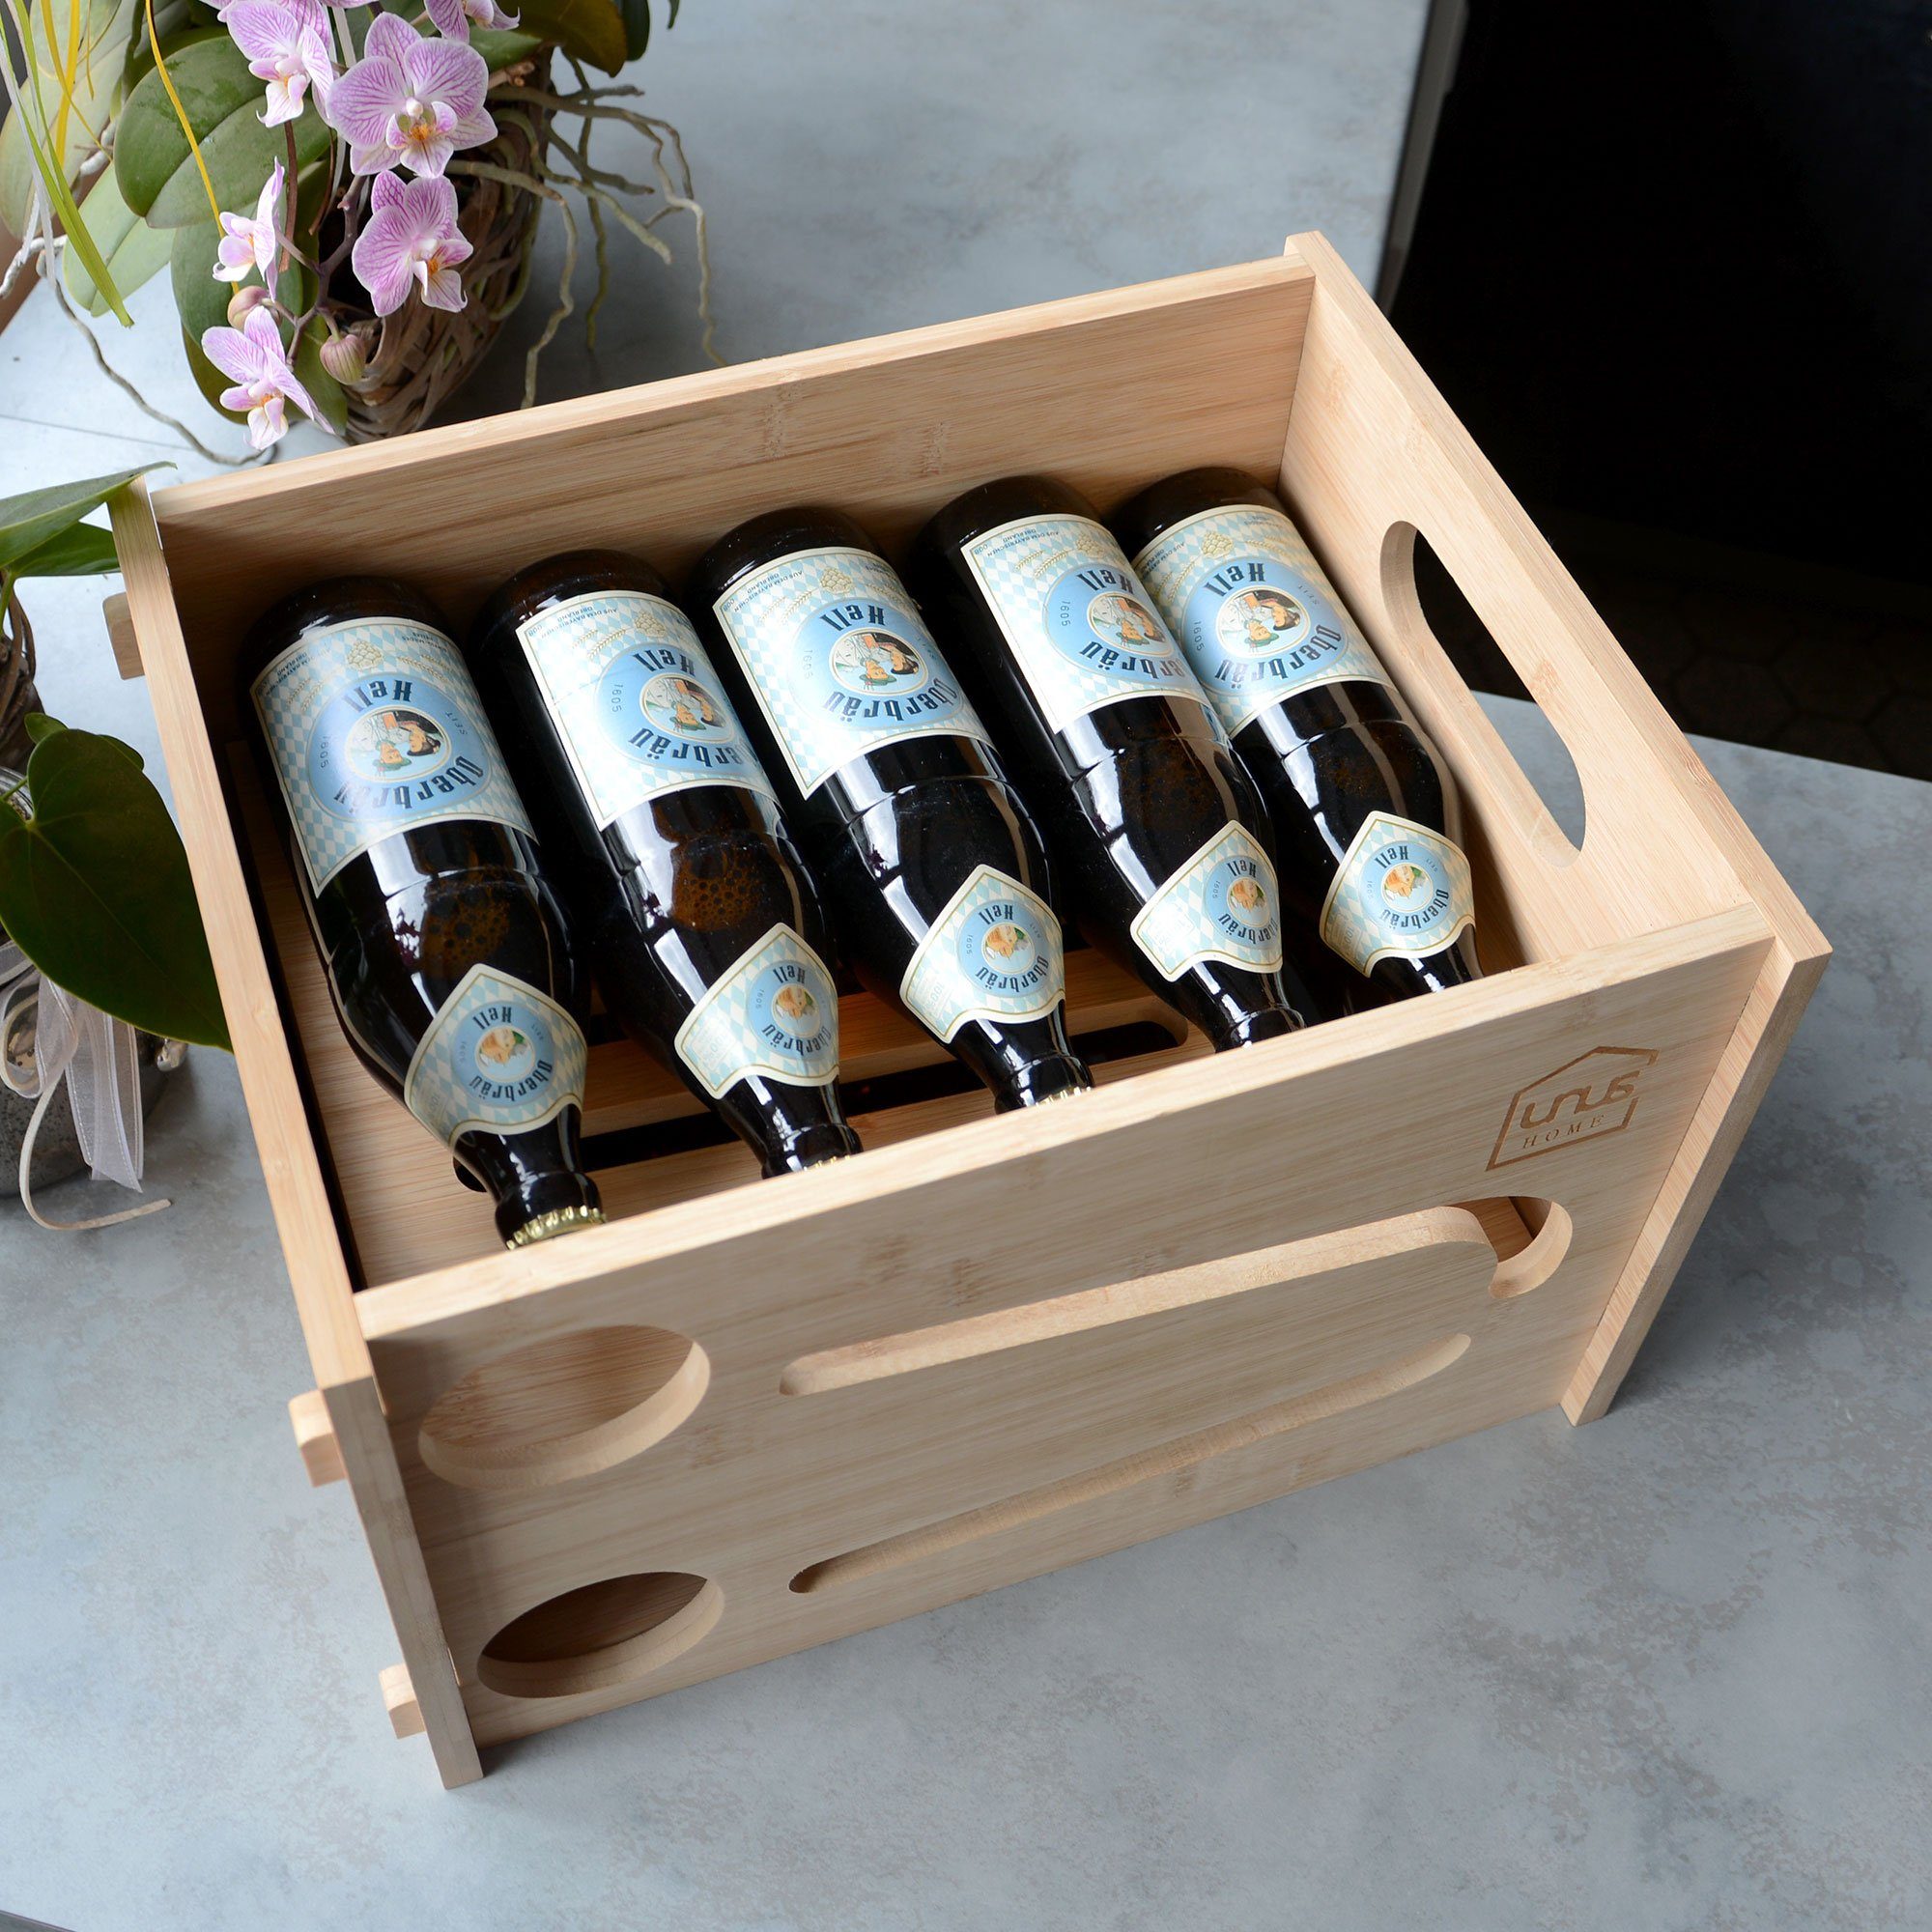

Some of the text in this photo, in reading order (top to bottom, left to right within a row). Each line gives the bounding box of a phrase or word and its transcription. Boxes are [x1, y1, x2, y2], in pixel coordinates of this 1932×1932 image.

[1077, 569, 1135, 594] Hell
[1204, 562, 1265, 597] Hell
[820, 604, 886, 632] Hell
[1060, 600, 1071, 627] 1605
[1192, 620, 1206, 651] 1605
[633, 649, 696, 677] Hell
[1214, 624, 1342, 689] Oberbräu
[343, 679, 412, 713] Hell
[611, 683, 624, 713] 1605
[822, 677, 958, 723] Oberbräu
[1227, 860, 1257, 878] Hell
[1374, 845, 1408, 868] Hell
[979, 904, 1013, 924] Hell
[1380, 889, 1450, 930] Oberbräu
[773, 965, 805, 983] Hell
[975, 954, 1049, 993] Oberbräu
[472, 1007, 512, 1030] Hell
[469, 1060, 554, 1102] Oberbräu
[1522, 1114, 1605, 1149] HOME
